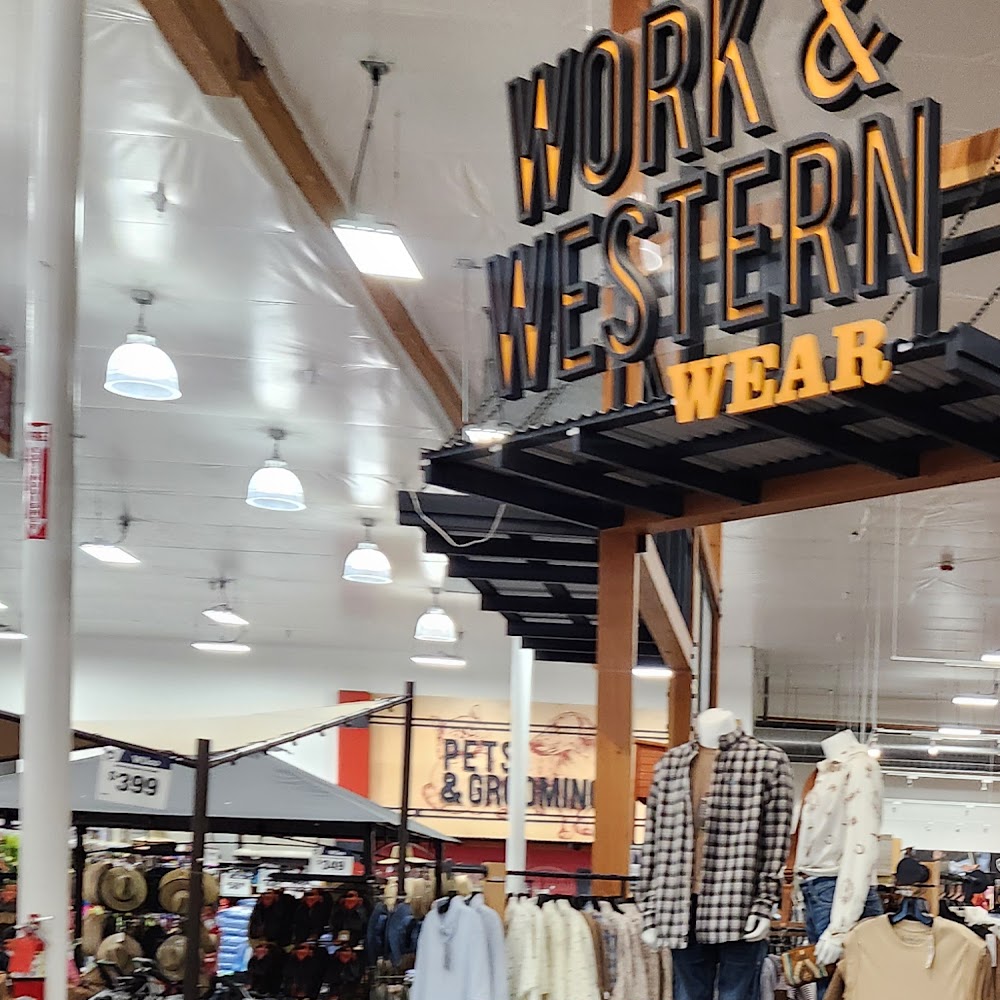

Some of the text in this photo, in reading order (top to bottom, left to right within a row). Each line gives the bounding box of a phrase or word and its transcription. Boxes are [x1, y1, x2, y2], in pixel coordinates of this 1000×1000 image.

[505, 0, 902, 225] WORK &
[486, 97, 941, 400] WESTERN
[667, 319, 893, 424] WEAR
[440, 772, 461, 804] &
